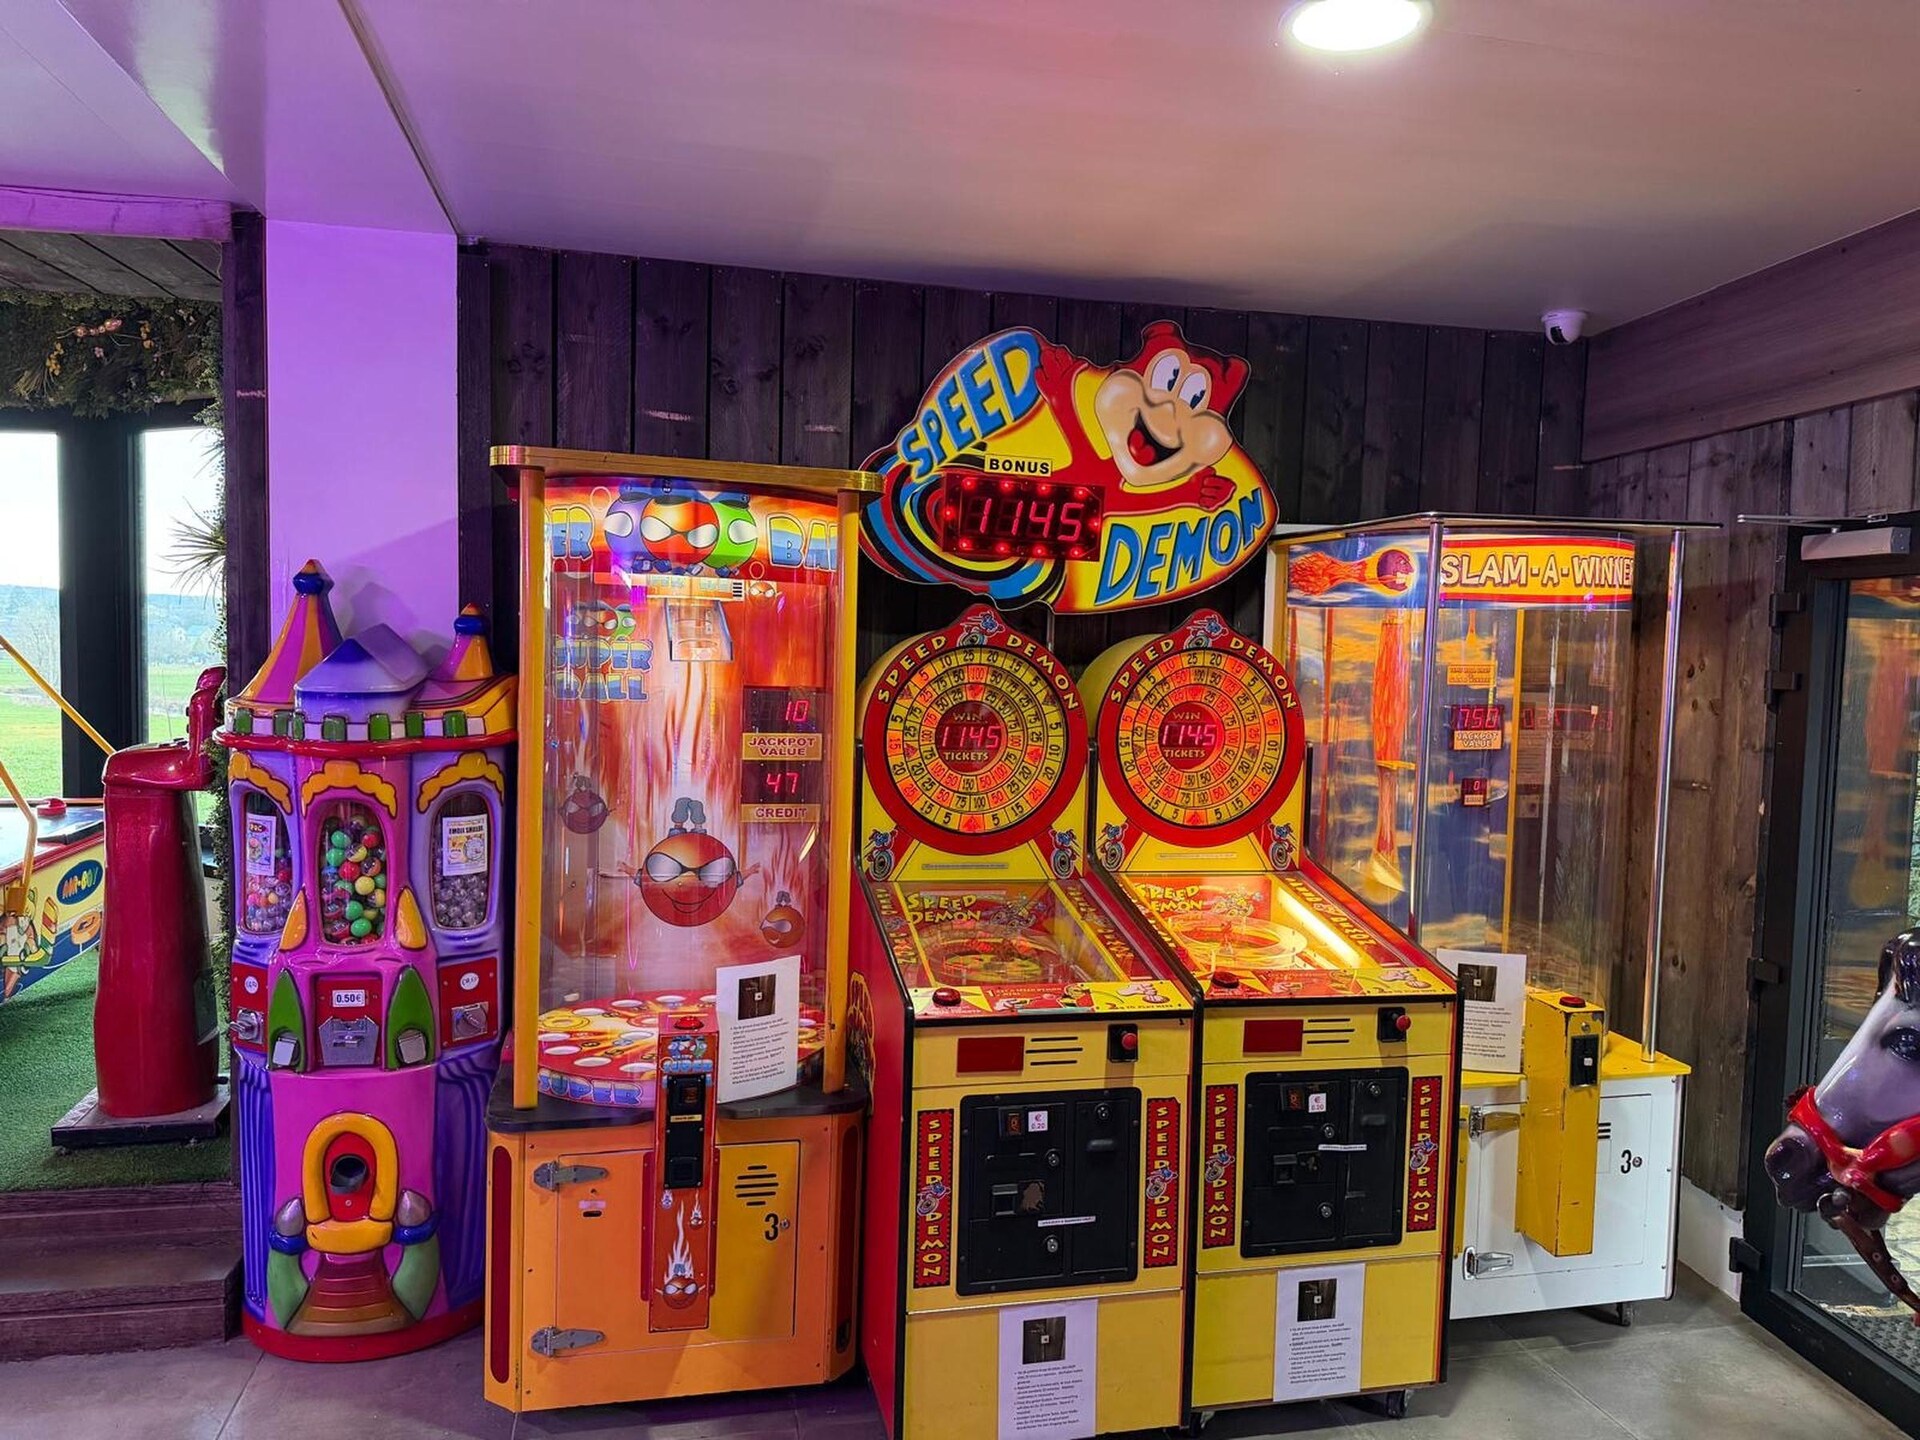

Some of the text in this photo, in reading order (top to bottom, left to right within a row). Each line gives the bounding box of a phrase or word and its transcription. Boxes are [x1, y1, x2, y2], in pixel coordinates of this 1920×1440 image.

[898, 330, 1267, 606] SPEED DEMON
[989, 458, 1050, 475] BONUS
[979, 497, 1086, 542] 1145
[545, 505, 594, 560] ER
[553, 637, 653, 672] SUPER
[963, 649, 975, 661] 25
[987, 650, 999, 663] 20
[1187, 653, 1198, 665] 25
[1209, 653, 1222, 666] 20
[941, 655, 953, 669] 10
[1009, 658, 1023, 672] 15
[1164, 660, 1175, 673] 10
[878, 634, 1079, 709] SPEED DEMON
[919, 670, 930, 682] 5
[1110, 637, 1297, 709] SPEED DEMON
[1029, 676, 1039, 687] 5
[1146, 673, 1156, 685] 5
[1247, 676, 1258, 687] 5
[553, 672, 649, 703] BALL
[785, 700, 809, 722] 10
[952, 712, 984, 721] WIN
[1172, 711, 1201, 720] WIN
[891, 713, 904, 724] 5
[1049, 721, 1062, 730] 5
[1122, 715, 1133, 723] 5
[1266, 718, 1279, 726] 5
[1459, 708, 1500, 729] 750
[749, 737, 815, 746] JACKPOT
[942, 726, 1002, 748] 1145
[1119, 736, 1130, 748] 15
[1162, 725, 1216, 746] 1145
[1457, 732, 1497, 740] JACKPOT
[889, 737, 901, 750] 15
[1048, 744, 1061, 757] 10
[1267, 740, 1279, 752] 10
[760, 748, 806, 756] VALUE
[943, 752, 989, 760] TICKETS
[1164, 749, 1206, 758] TICKETS
[892, 761, 907, 776] 20
[1123, 758, 1136, 773] 20
[1261, 761, 1273, 776] 20
[1043, 766, 1056, 780] 20
[766, 772, 799, 793] 47
[1132, 781, 1146, 794] 25
[1248, 781, 1262, 796] 25
[903, 783, 919, 797] 25
[1029, 786, 1042, 801] 25
[920, 800, 935, 815] 15
[1010, 801, 1025, 817] 15
[1148, 796, 1161, 810] 15
[1232, 797, 1244, 811] 15
[756, 808, 807, 818] CREDIT
[942, 812, 952, 825] 5
[991, 813, 1001, 826] 5
[1172, 808, 1180, 820] 5
[1214, 808, 1222, 820] 5
[906, 893, 977, 910] SPEED
[1150, 900, 1204, 912] EMON
[908, 909, 981, 925] DEMON
[336, 993, 363, 1003] 0.50€
[1412, 1084, 1432, 1223] SPEED DEMON
[1208, 1093, 1229, 1238] SPEED DEMON
[1621, 1149, 1632, 1174] 3
[1150, 1106, 1172, 1257] SPEED DEMON
[920, 1119, 944, 1277] SPEED DEMON
[764, 1212, 779, 1241] 3
